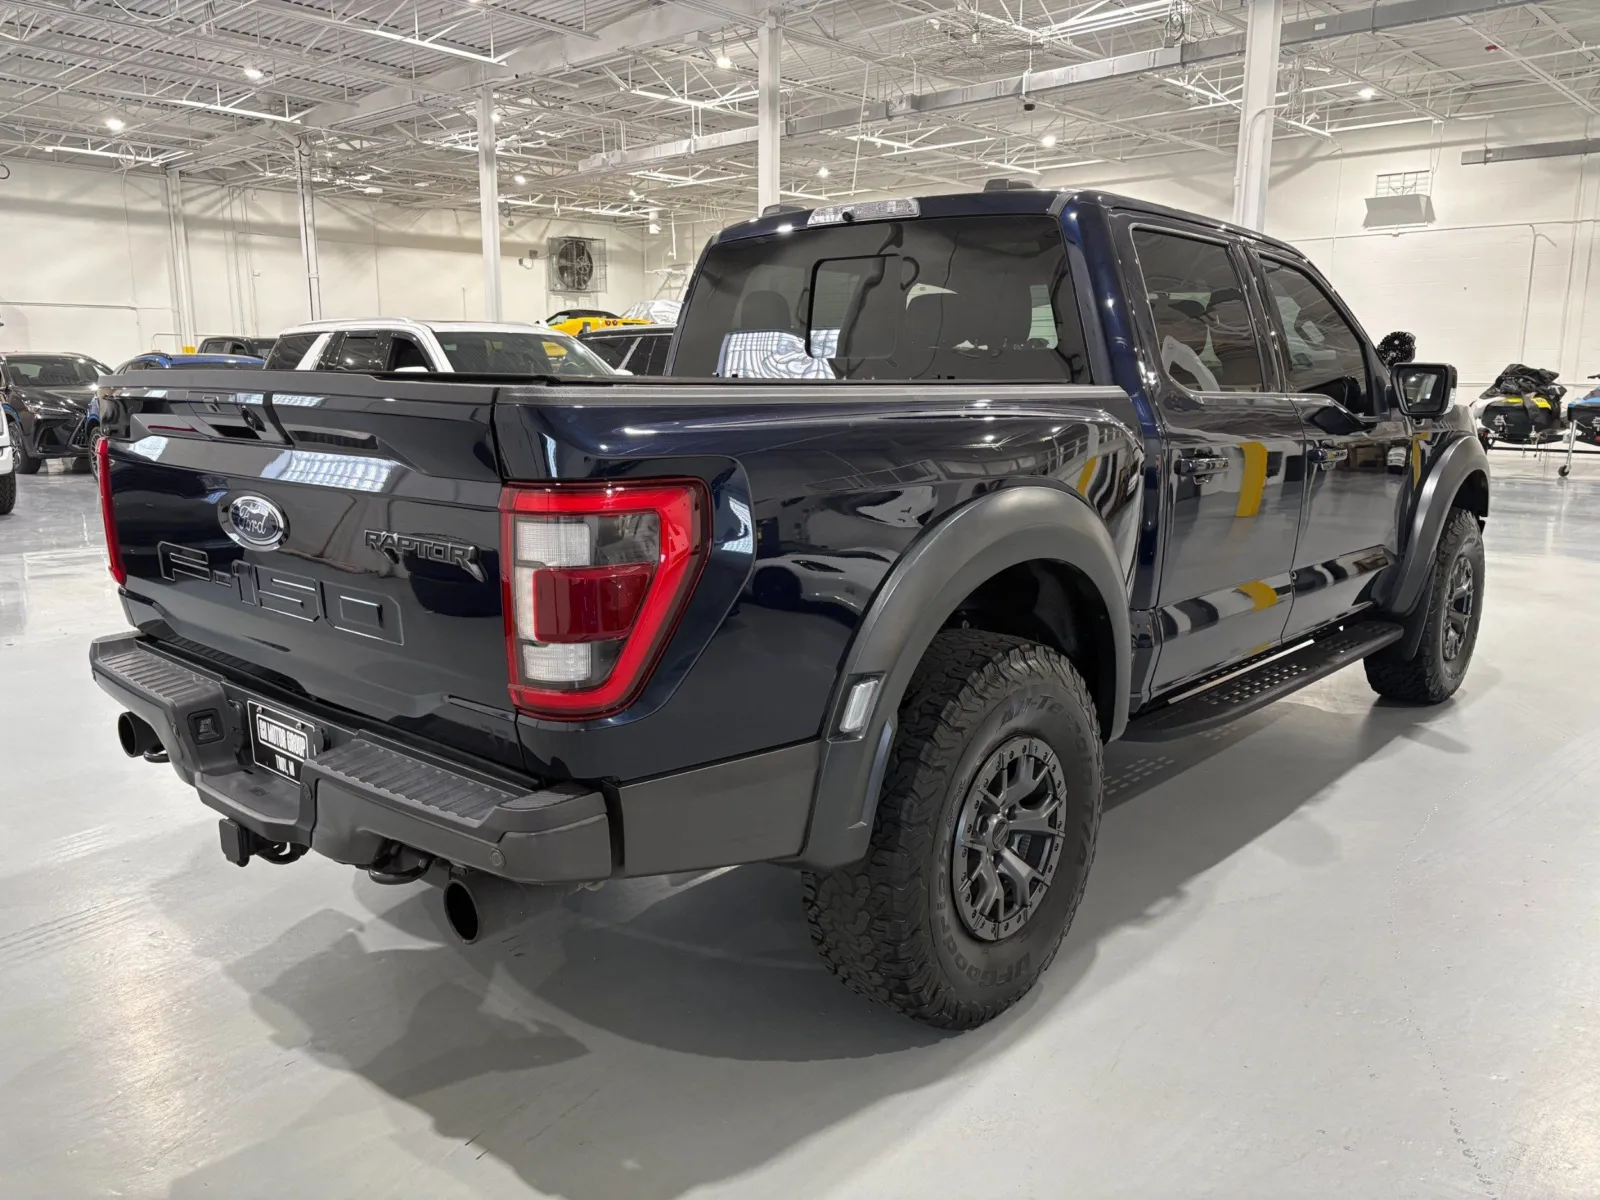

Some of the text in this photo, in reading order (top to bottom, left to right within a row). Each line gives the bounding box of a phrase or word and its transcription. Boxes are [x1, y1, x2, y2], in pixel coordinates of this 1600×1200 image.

[239, 505, 267, 535] Ford
[364, 529, 486, 583] RAPTOR
[157, 541, 405, 646] F-150
